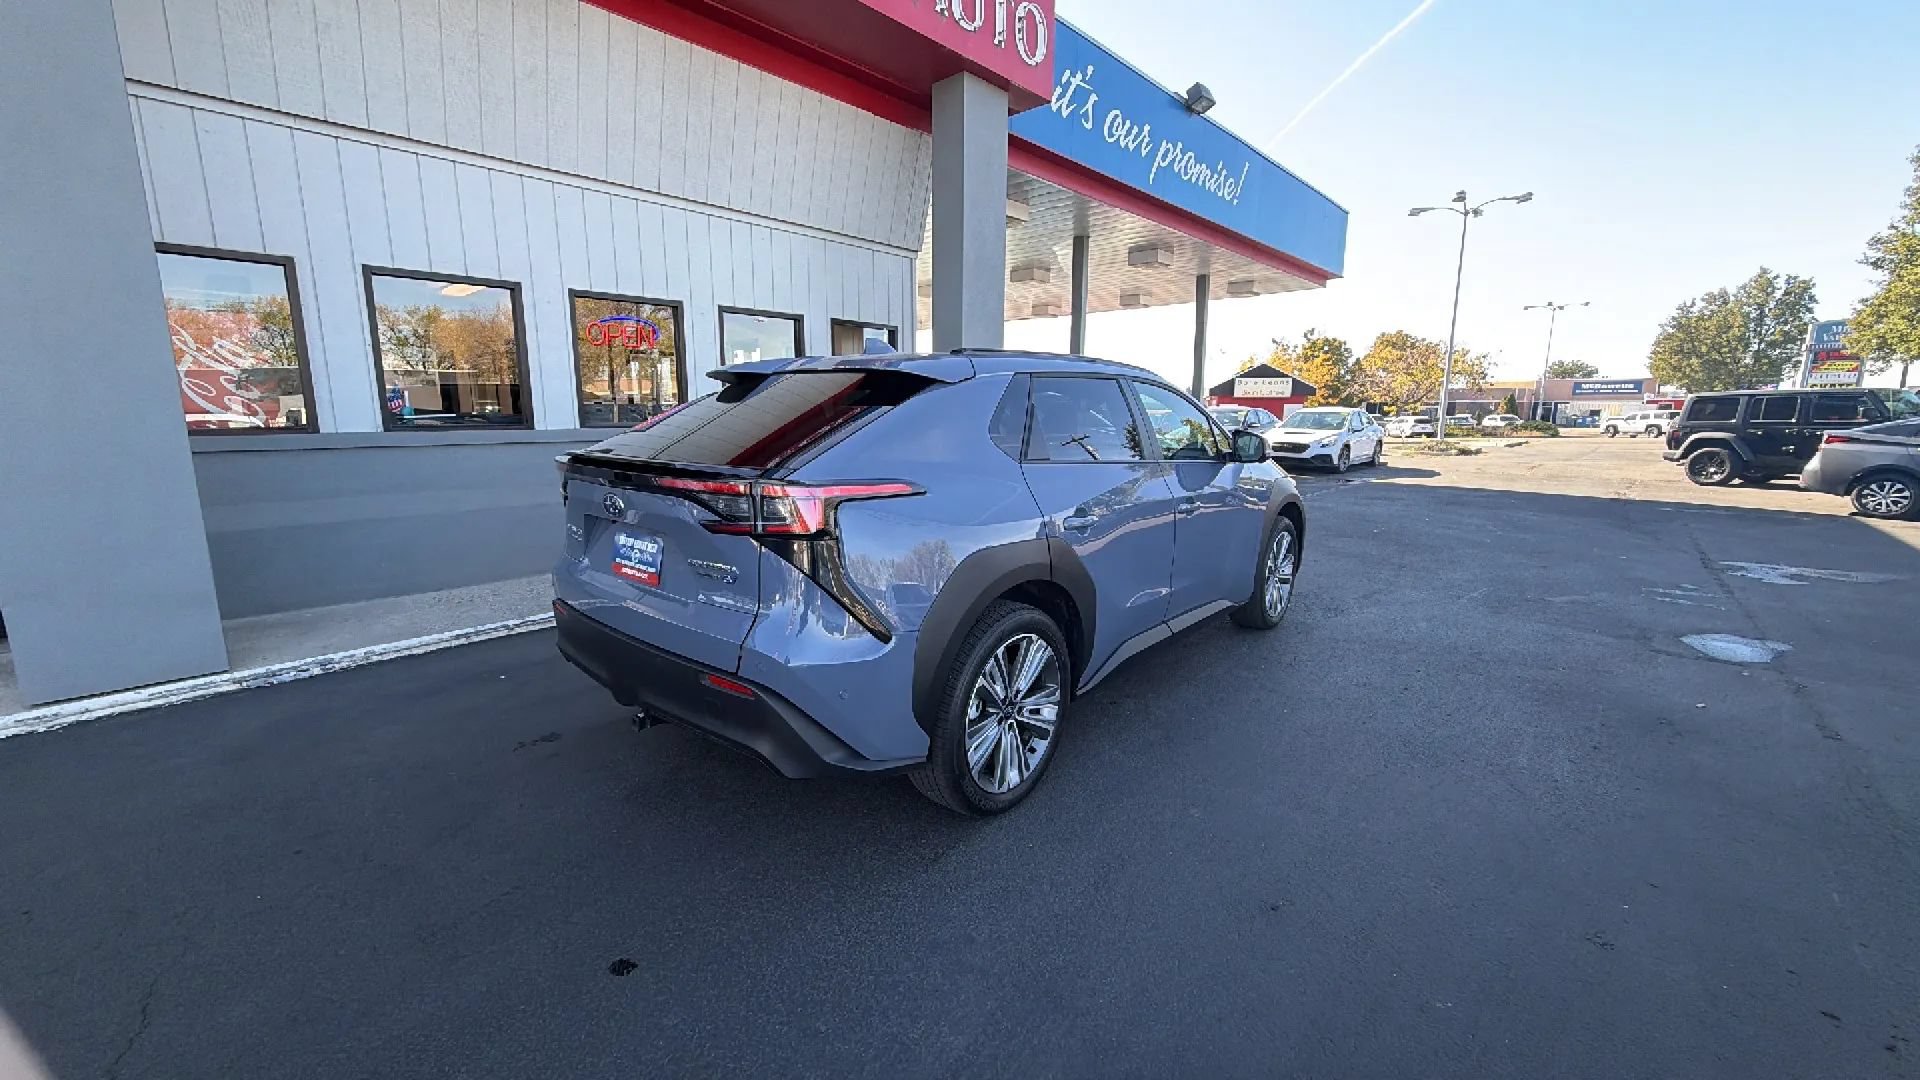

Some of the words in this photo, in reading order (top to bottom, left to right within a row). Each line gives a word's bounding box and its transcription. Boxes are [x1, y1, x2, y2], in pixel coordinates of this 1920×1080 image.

[934, 0, 1048, 66] UTO
[1050, 65, 1099, 129] it's
[1103, 109, 1153, 157] our
[1150, 138, 1249, 205] promise!
[586, 321, 656, 350] OPEN
